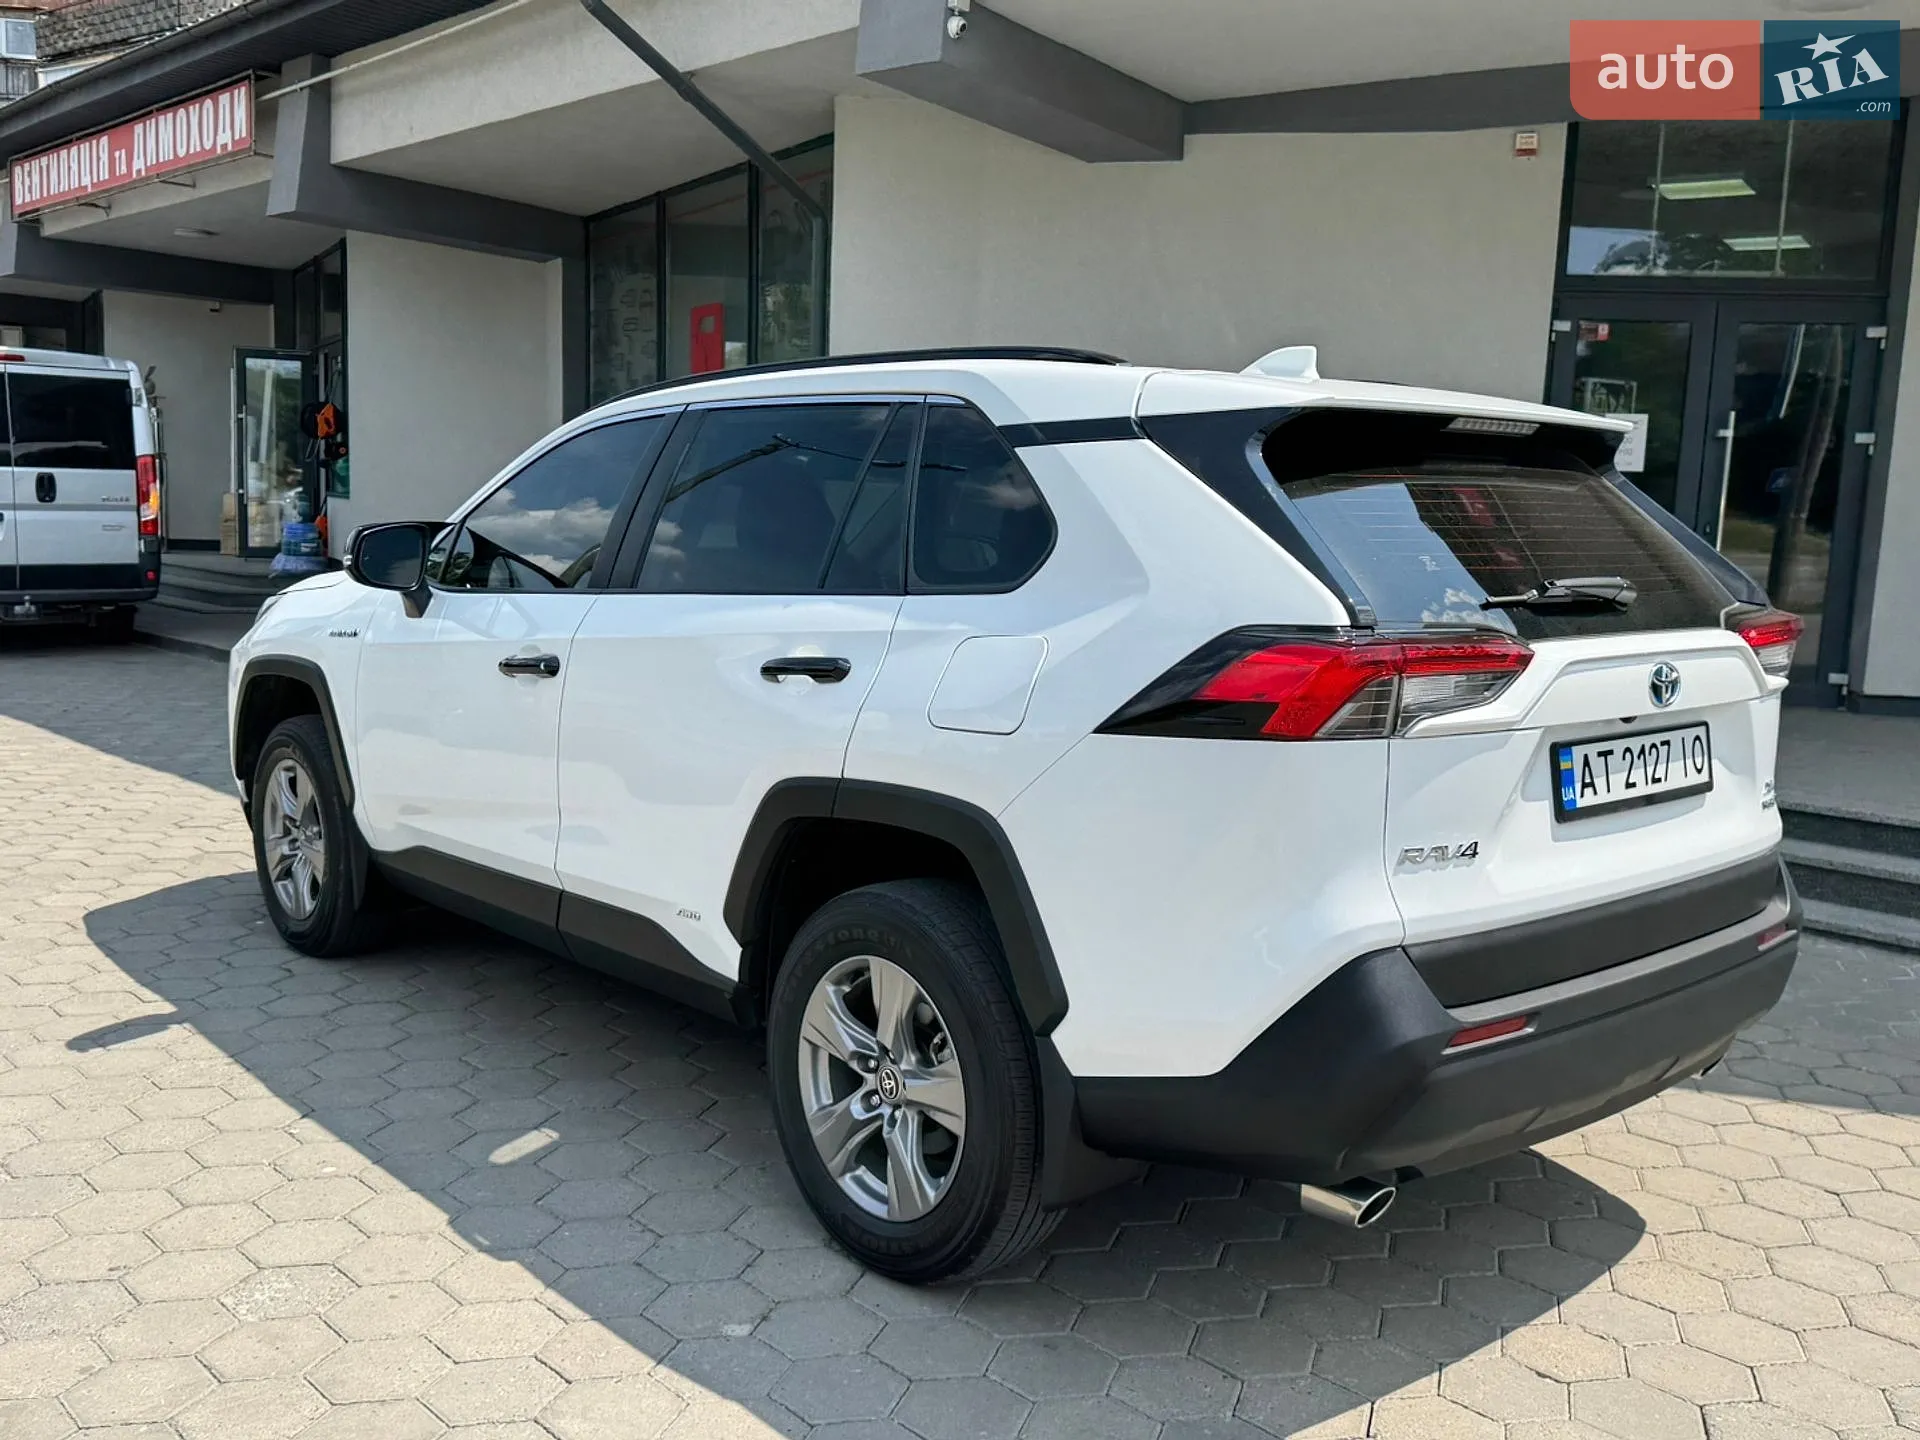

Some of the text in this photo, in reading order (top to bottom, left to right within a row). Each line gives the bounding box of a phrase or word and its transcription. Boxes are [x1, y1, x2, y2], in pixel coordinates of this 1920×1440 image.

[13, 134, 110, 206] ВЕНТИЛЯЦІЯ
[132, 86, 248, 179] ДИМОХОДИ
[1580, 734, 1705, 798] AT 2127 IO
[1561, 786, 1575, 801] UA
[1396, 841, 1479, 867] RAV4
